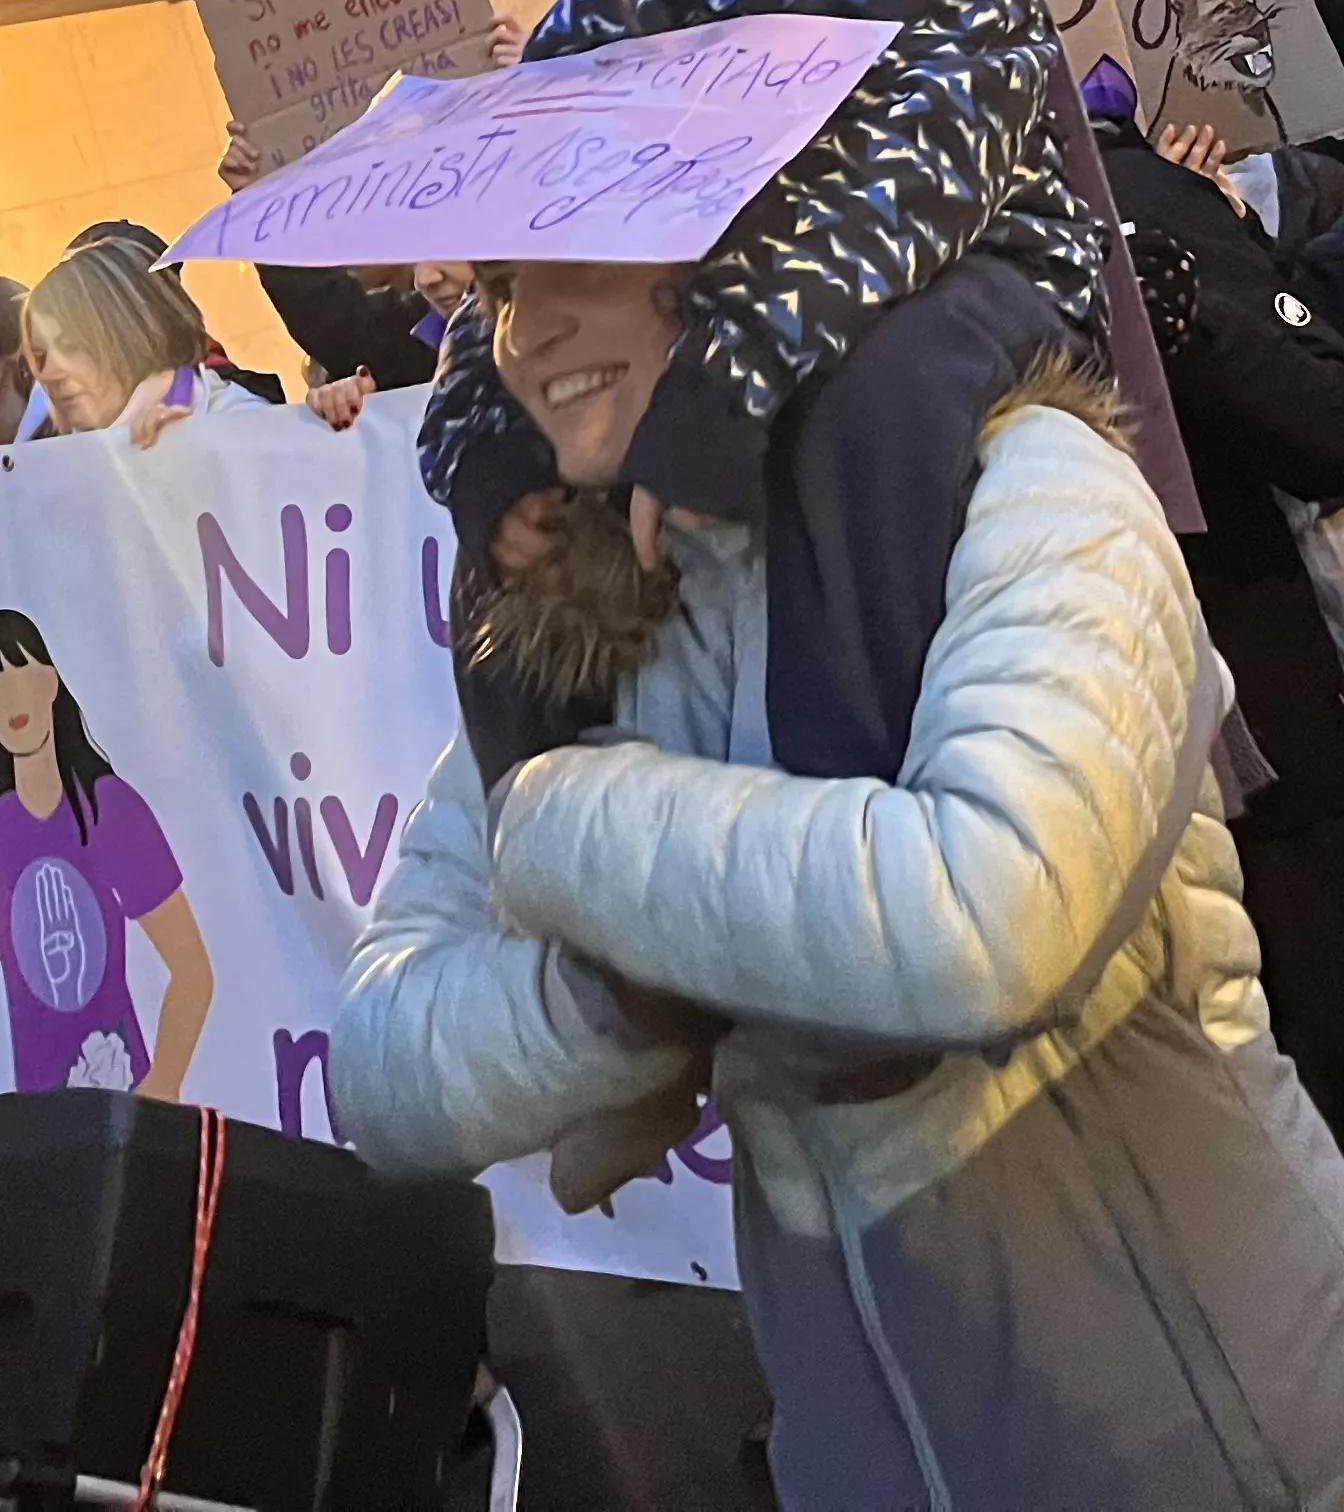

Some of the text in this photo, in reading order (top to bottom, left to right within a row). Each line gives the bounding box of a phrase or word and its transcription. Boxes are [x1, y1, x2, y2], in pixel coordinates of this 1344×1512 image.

[249, 32, 280, 62] no
[294, 10, 331, 41] me
[332, 32, 374, 70] LES
[197, 503, 354, 668] Ni
[242, 751, 399, 907] viv
